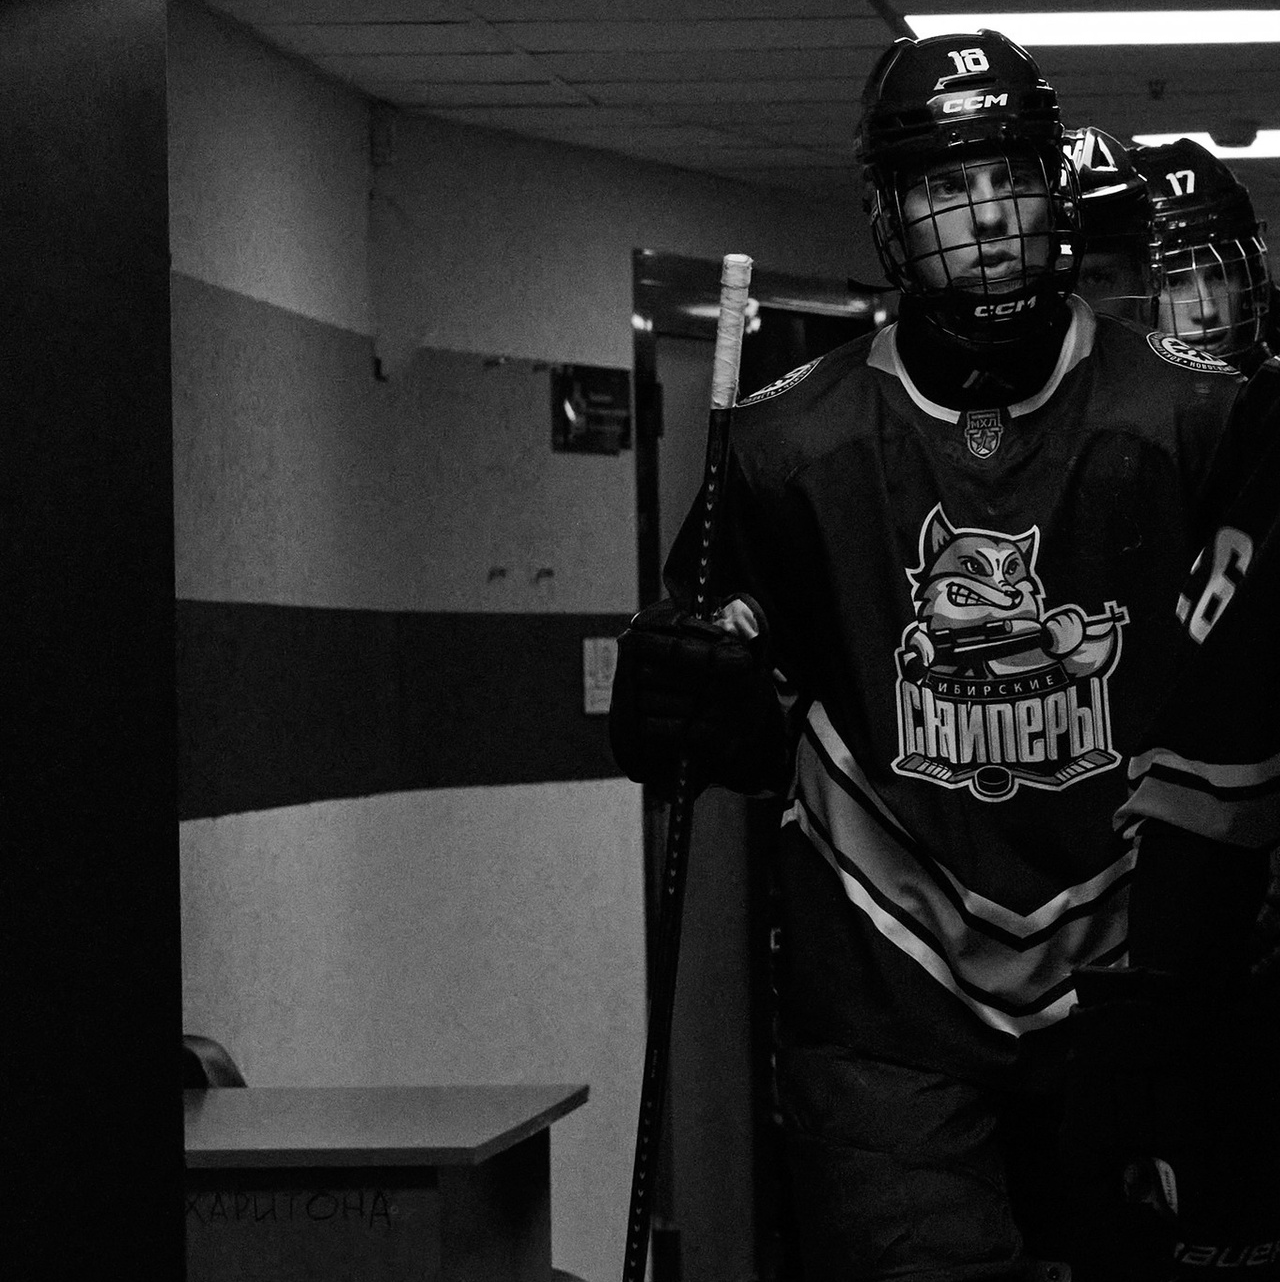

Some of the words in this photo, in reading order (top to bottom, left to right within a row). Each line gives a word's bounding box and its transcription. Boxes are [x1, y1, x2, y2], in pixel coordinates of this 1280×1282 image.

[947, 47, 990, 75] 18
[942, 92, 1009, 114] CCM
[1165, 169, 1196, 197] 17
[973, 294, 1038, 318] CCM
[937, 674, 1055, 697] ИБИРСКИЕ
